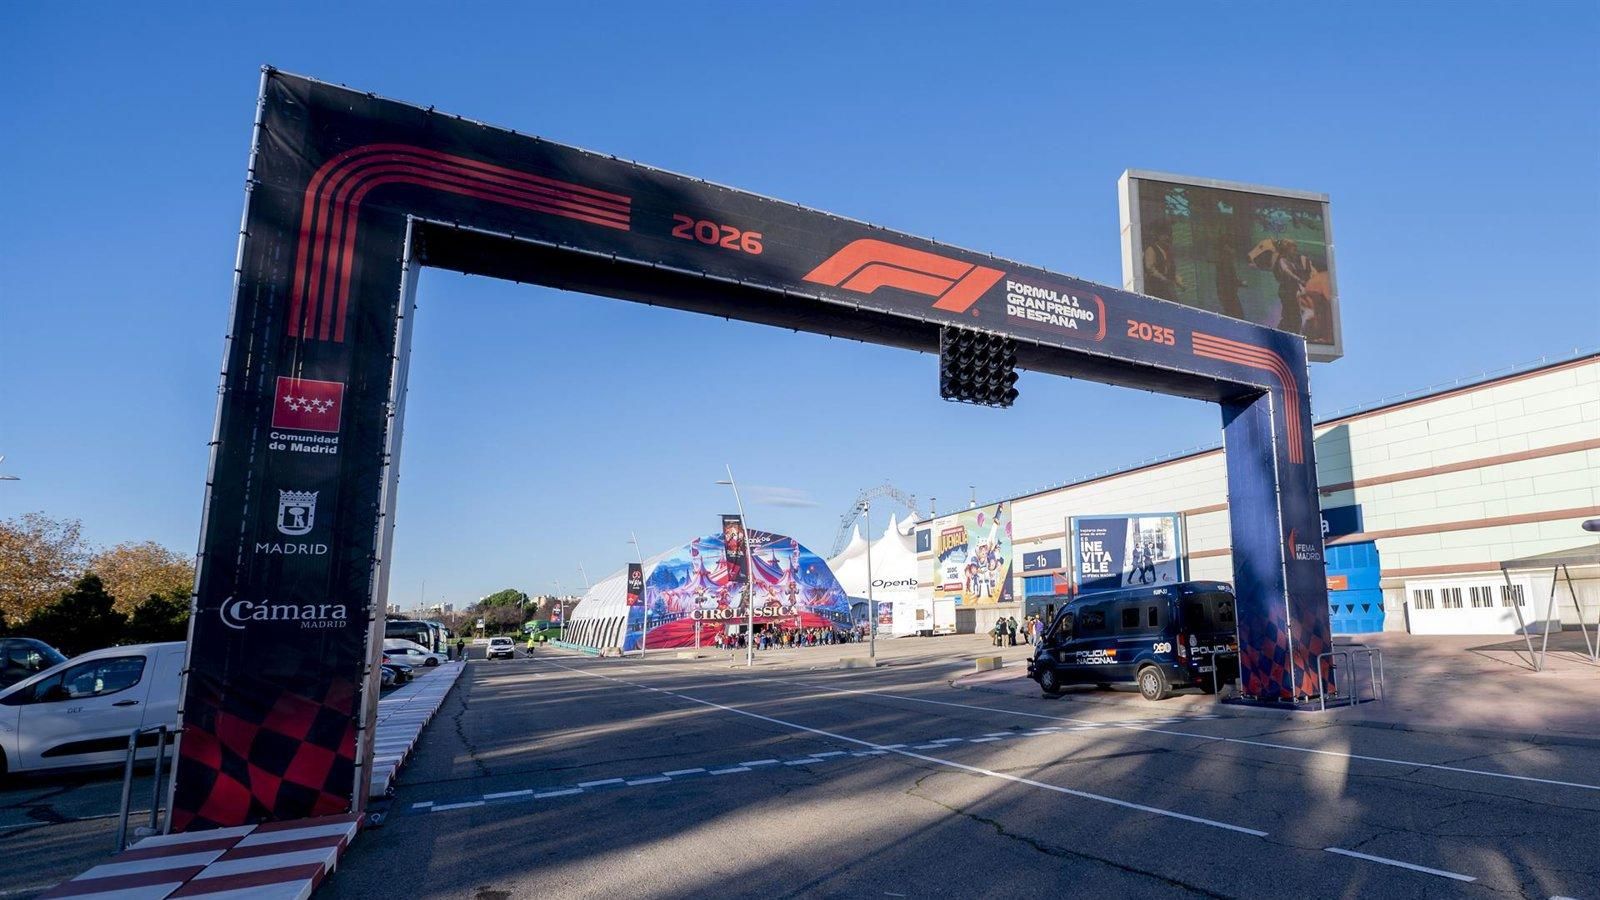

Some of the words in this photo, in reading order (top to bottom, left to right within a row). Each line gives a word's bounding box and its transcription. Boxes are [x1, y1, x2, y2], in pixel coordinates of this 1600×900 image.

[672, 214, 763, 255] 2026
[1006, 280, 1071, 306] FORMULA
[1072, 296, 1080, 307] 1
[1006, 294, 1046, 311] GRAN
[1047, 302, 1094, 322] PREMIO
[1007, 305, 1026, 318] DE
[1027, 309, 1078, 330] ESPAÑA
[1127, 319, 1175, 346] 2035
[270, 431, 339, 444] Comunidad
[269, 442, 286, 451] de
[291, 443, 338, 454] Madrid
[924, 533, 929, 548] 1
[1081, 541, 1102, 551] INE
[255, 543, 328, 555] MADRID
[1296, 544, 1315, 552] IFEMA
[1036, 554, 1047, 567] 1b
[1081, 551, 1112, 562] VITA
[1296, 552, 1321, 560] MADRID
[1082, 562, 1108, 573] BLE
[871, 578, 918, 588] Openb
[221, 597, 347, 625] Cámara
[690, 605, 798, 620] CIRCLASSICA
[300, 621, 347, 629] MADRID
[1076, 649, 1107, 657] POLICIA
[1190, 644, 1232, 655] POLICIA
